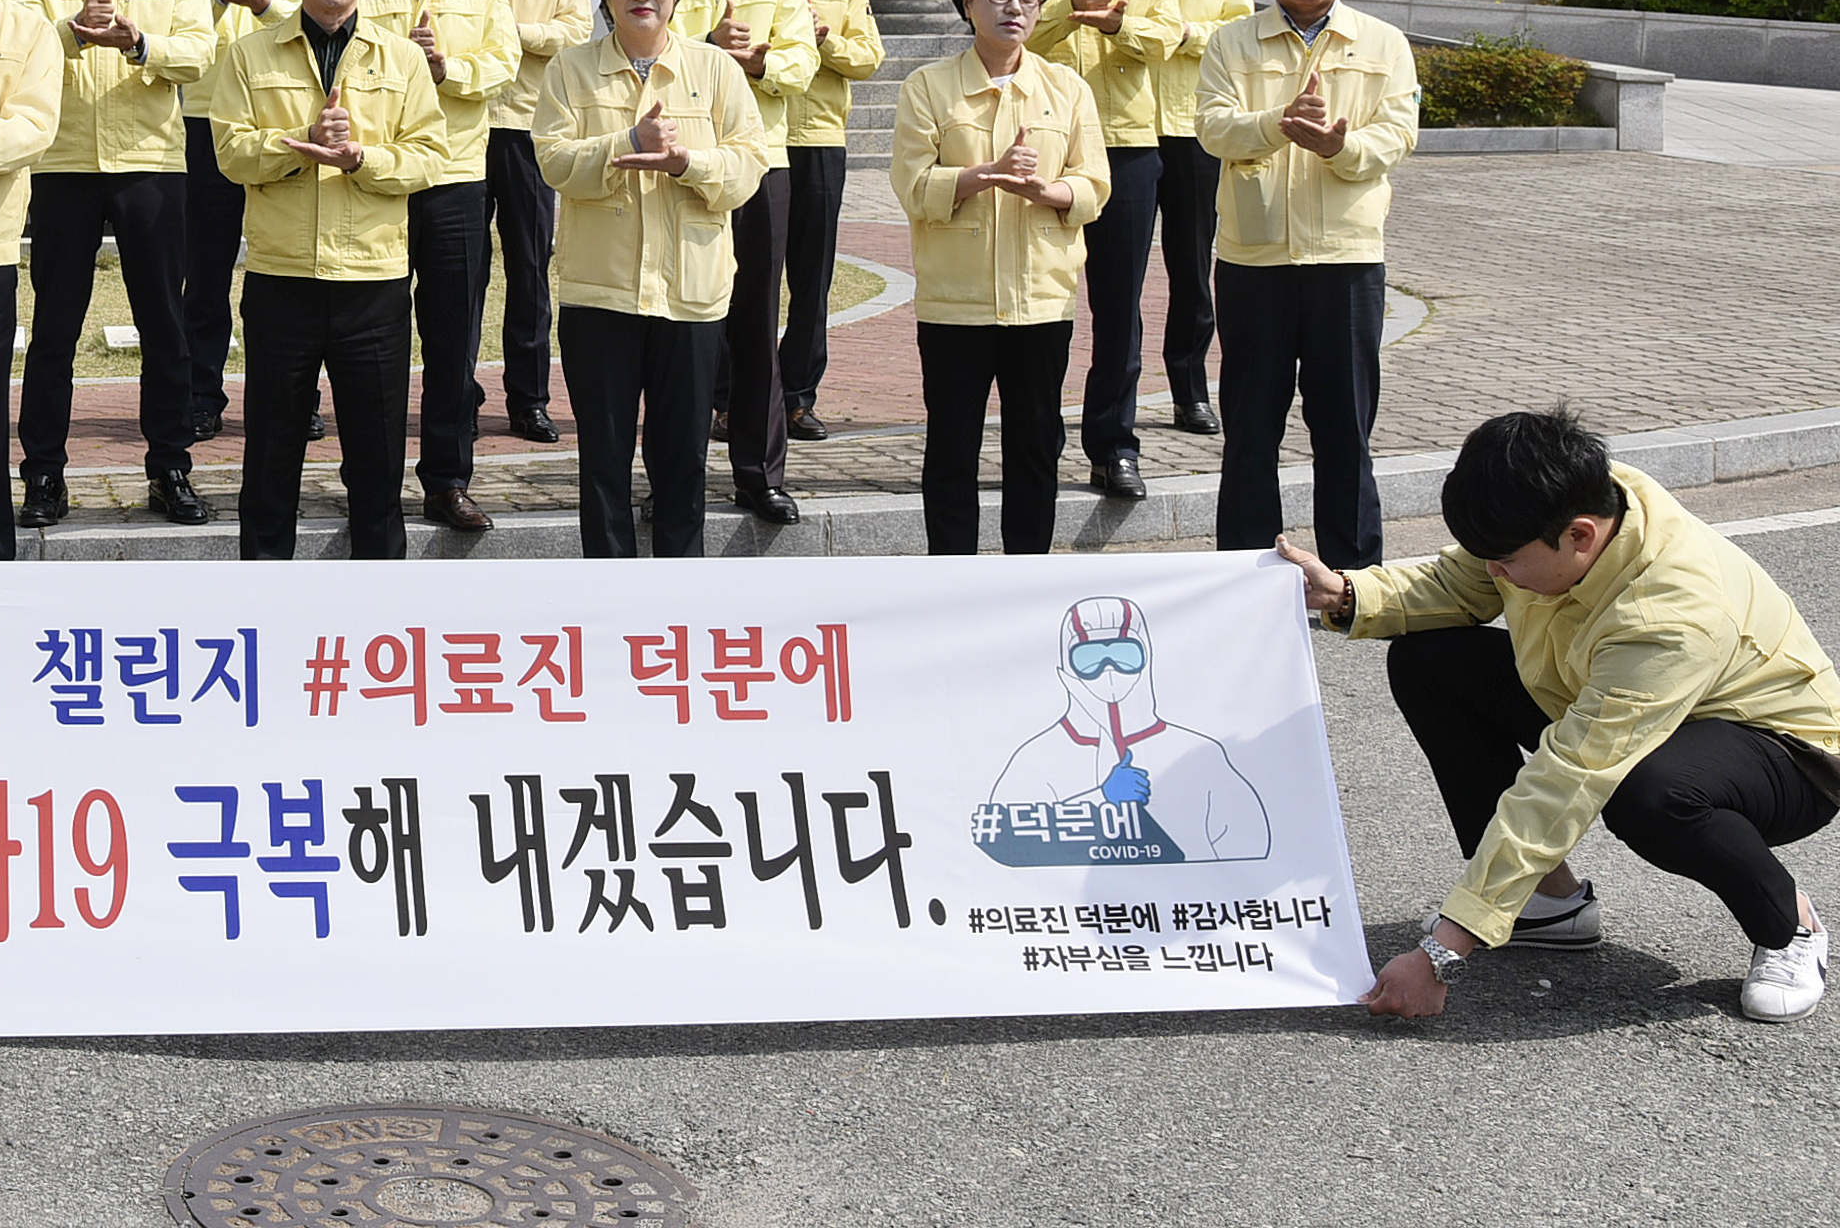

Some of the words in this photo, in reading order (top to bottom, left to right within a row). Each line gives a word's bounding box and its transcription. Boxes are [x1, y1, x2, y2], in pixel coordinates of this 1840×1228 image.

[32, 627, 259, 728] 챌린지
[303, 626, 587, 727] #의료진
[622, 623, 852, 725] 덕분에
[973, 801, 1142, 843] #덕분에
[166, 777, 428, 941] 극복해
[468, 770, 947, 934] 내겠습니다.
[1089, 844, 1162, 860] COVID-19
[968, 905, 1070, 935] #의료진
[1074, 902, 1161, 934] 덕분에
[1172, 895, 1332, 931] #감사합니다
[1022, 944, 1152, 973] #자부심을
[1160, 941, 1274, 973] 느낍니다
